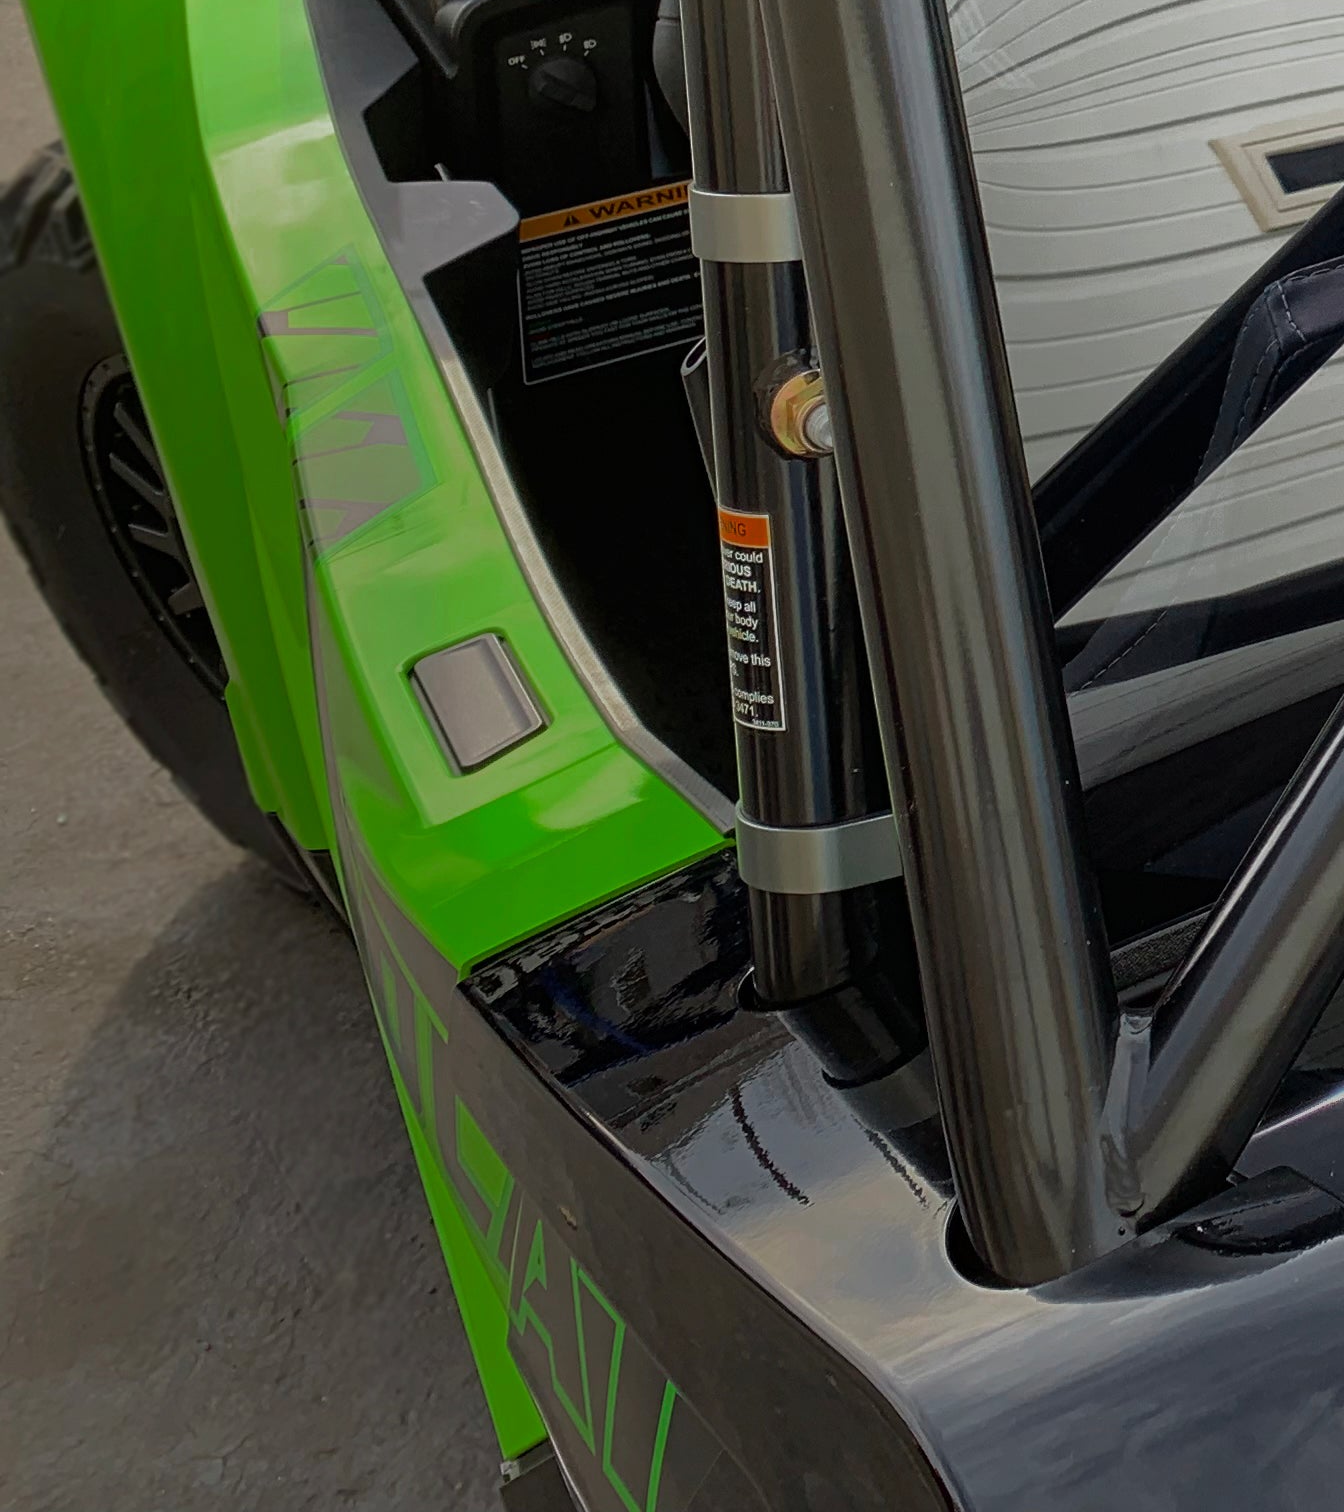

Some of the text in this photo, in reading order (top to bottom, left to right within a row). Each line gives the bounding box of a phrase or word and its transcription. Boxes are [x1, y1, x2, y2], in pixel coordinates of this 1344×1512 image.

[507, 54, 525, 66] OFF
[734, 551, 763, 564] could
[744, 601, 757, 613] all
[735, 613, 759, 631] body
[751, 653, 772, 668] this
